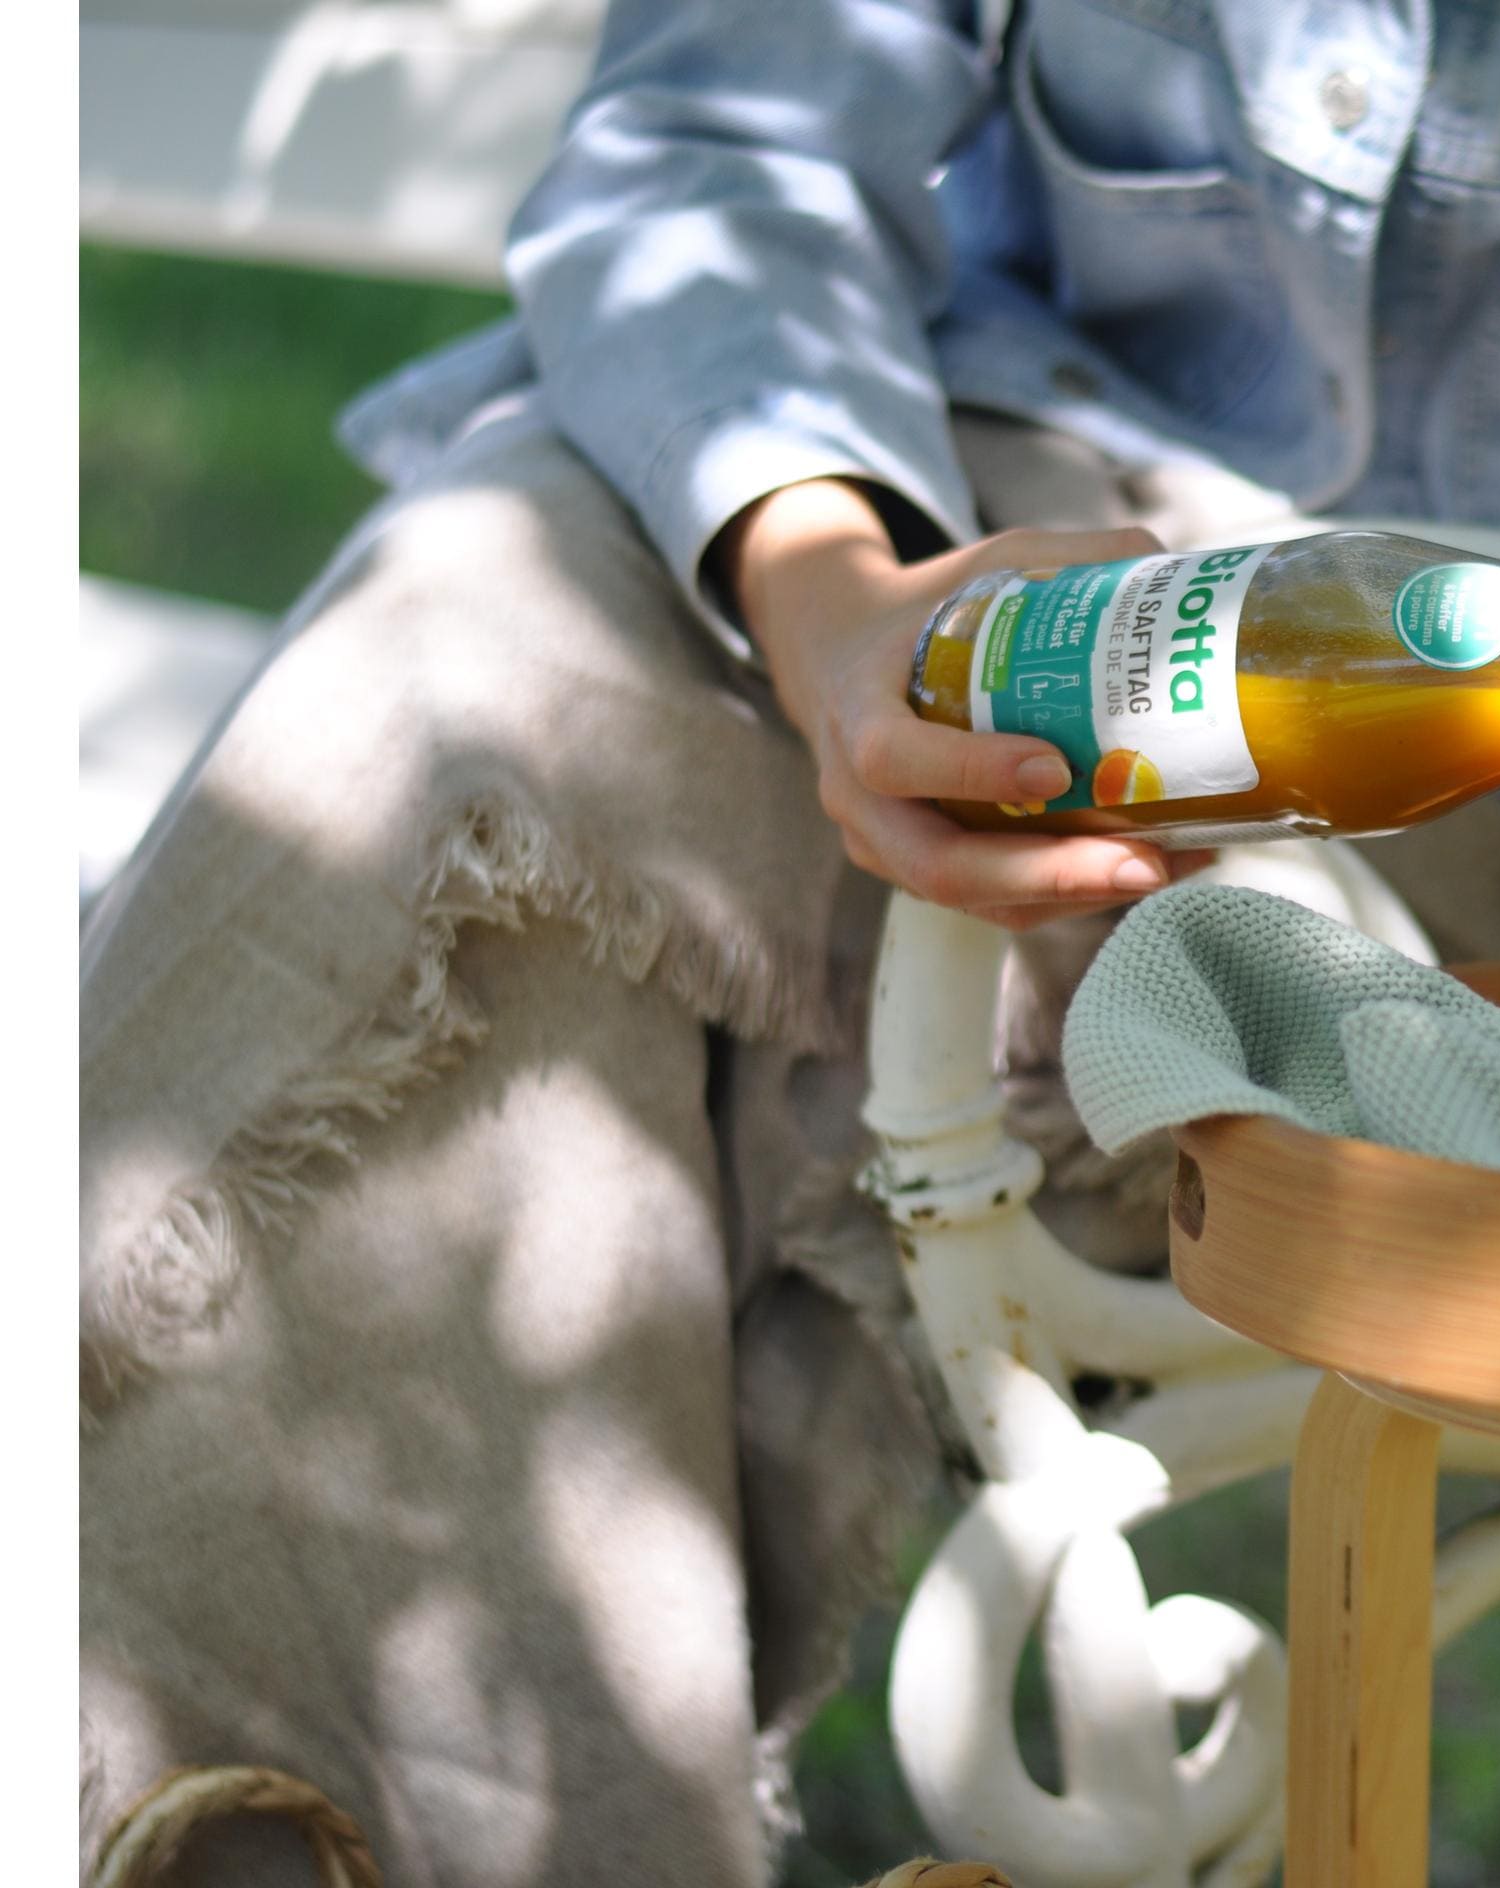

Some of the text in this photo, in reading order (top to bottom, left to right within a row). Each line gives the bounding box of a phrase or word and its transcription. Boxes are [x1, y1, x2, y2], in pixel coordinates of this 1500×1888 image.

[1062, 598, 1078, 608] &
[1068, 573, 1111, 647] Auszeit für
[1109, 575, 1145, 645] JOURNÉE
[1408, 596, 1423, 631] poivre
[1422, 596, 1437, 646] curcuma
[1036, 624, 1049, 651] pour
[1049, 609, 1075, 649] Geist
[1169, 549, 1259, 715] Biotta
[1106, 649, 1122, 675] DE
[1128, 600, 1162, 715] SAFTTAG
[1106, 681, 1124, 717] JUS
